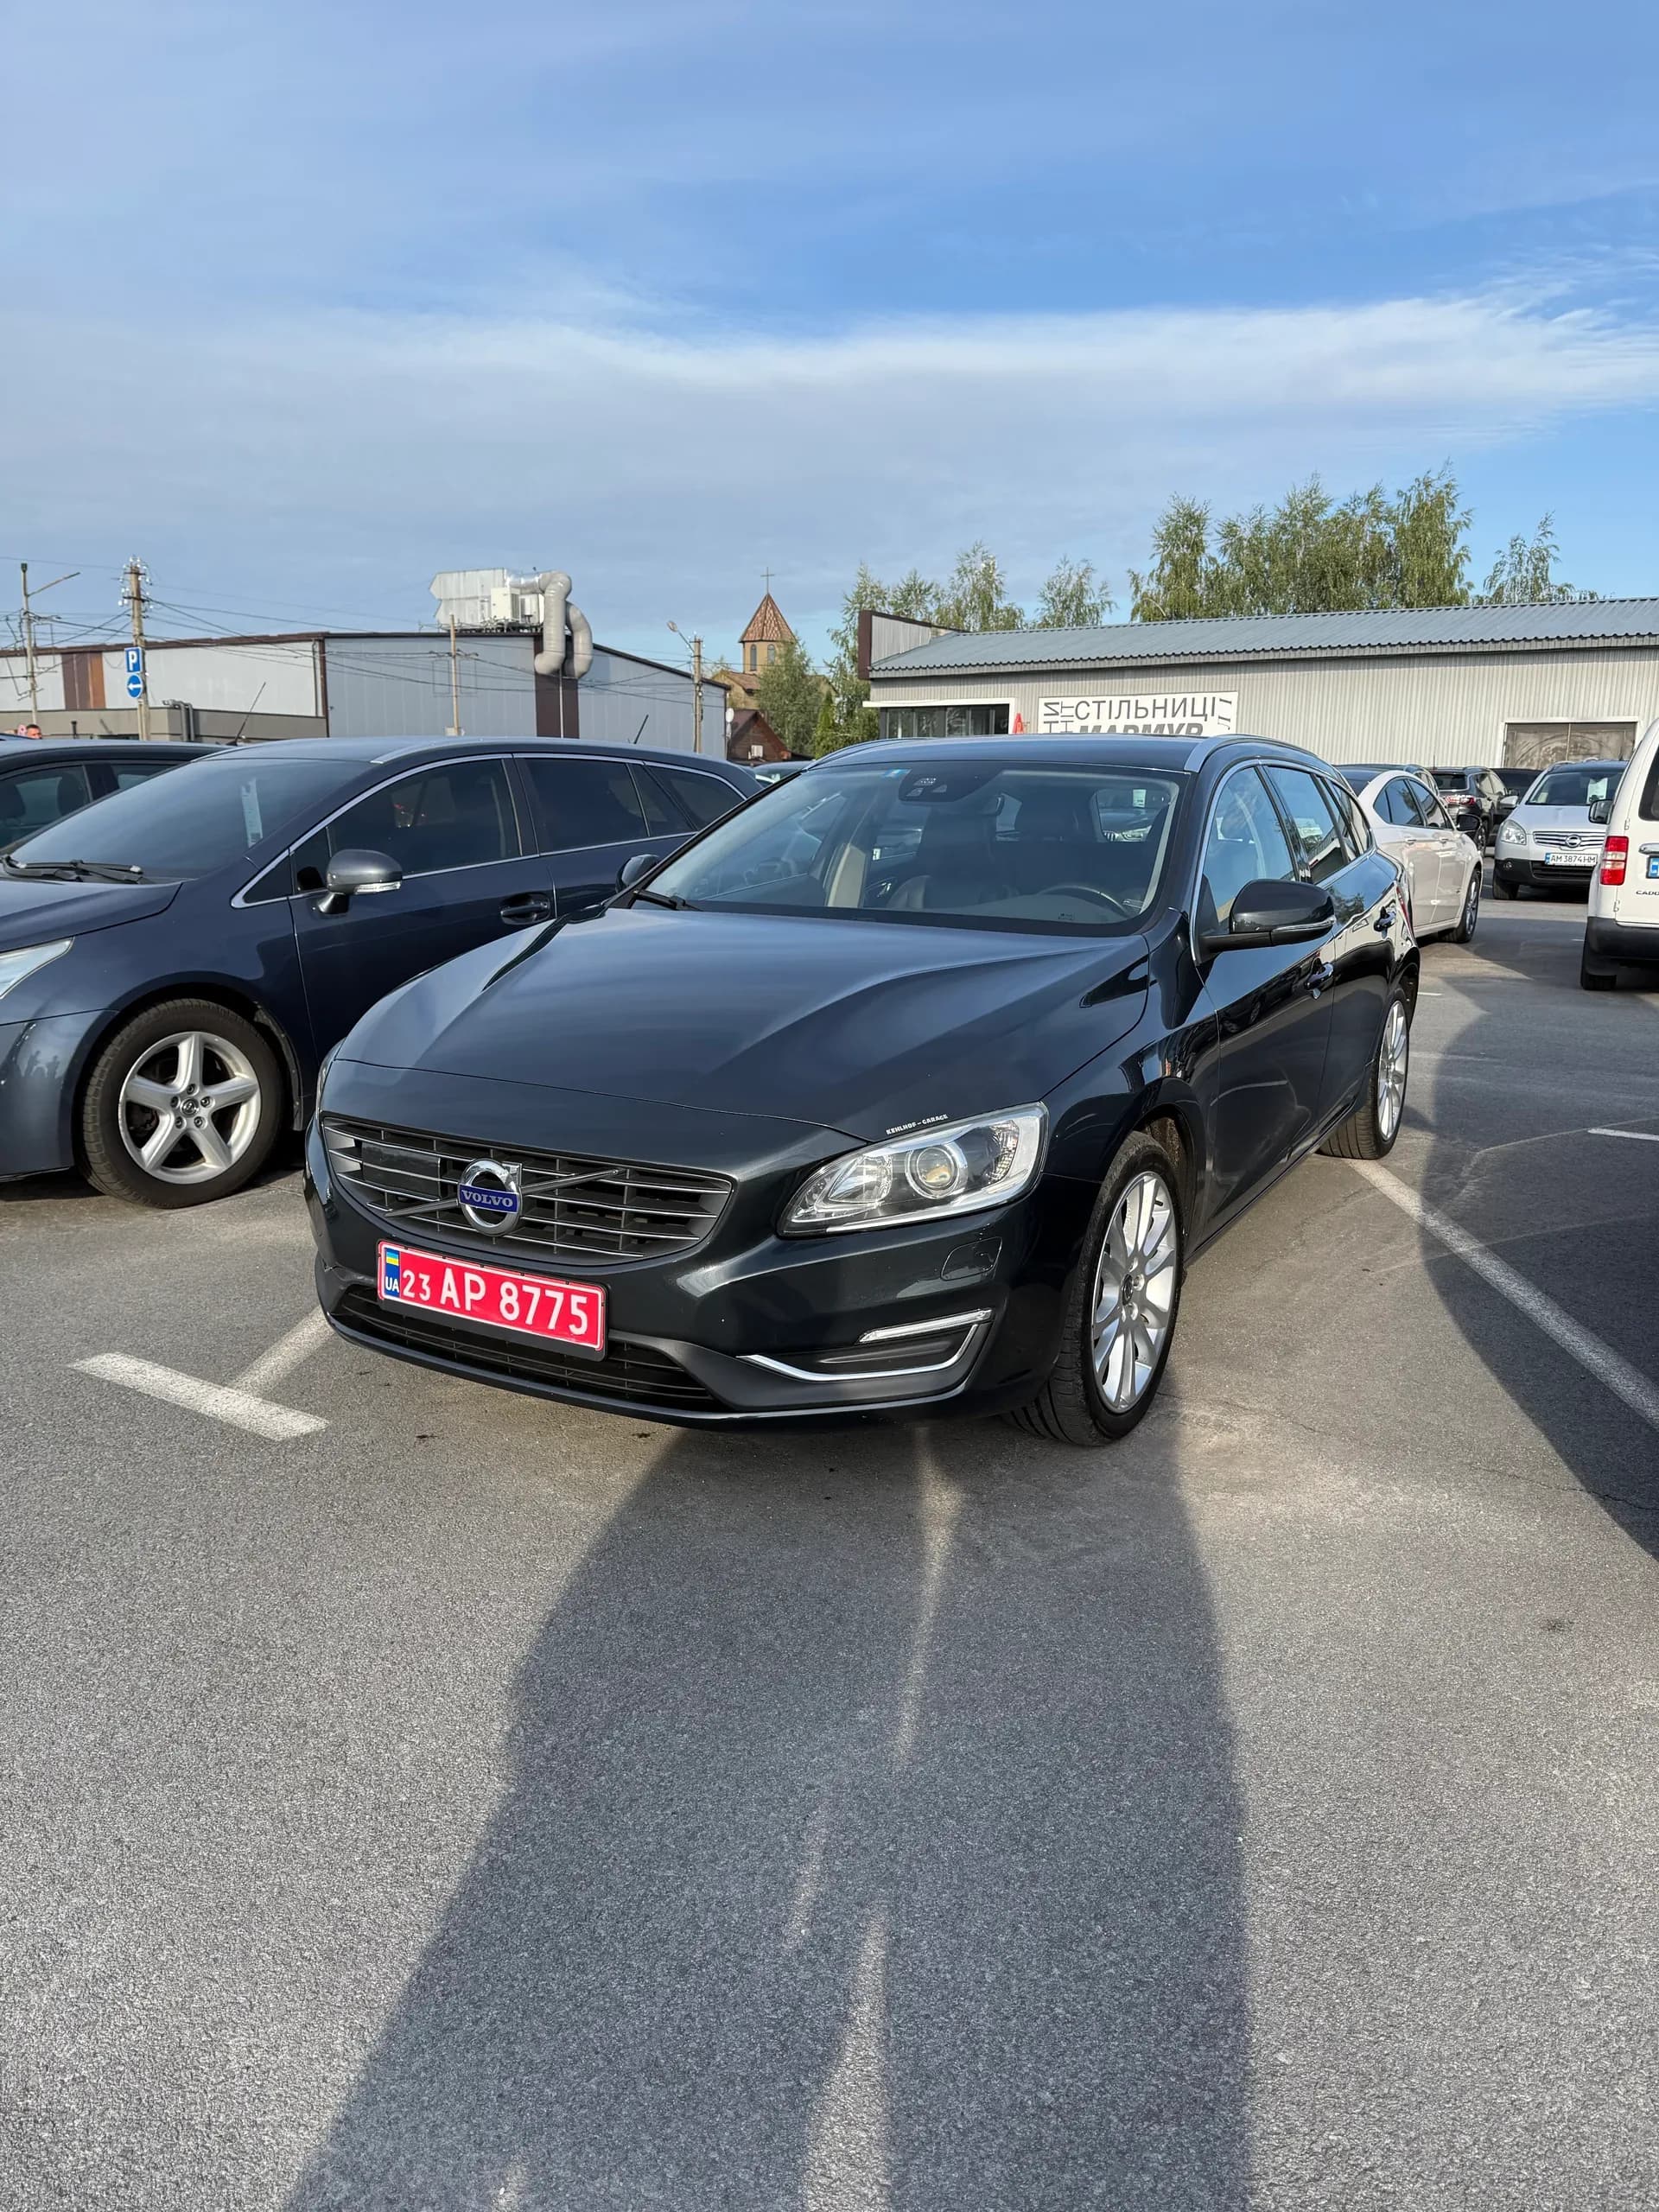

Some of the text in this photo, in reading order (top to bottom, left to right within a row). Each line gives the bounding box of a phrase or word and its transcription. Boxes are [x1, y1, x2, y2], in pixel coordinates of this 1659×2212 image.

[128, 651, 138, 671] P
[1075, 696, 1216, 721] СТІЛЬНИЦІ
[922, 1114, 949, 1125] GARAGE
[461, 1189, 513, 1208] VOLVO
[385, 1276, 400, 1294] UA
[402, 1267, 588, 1336] 23 AP 8775
